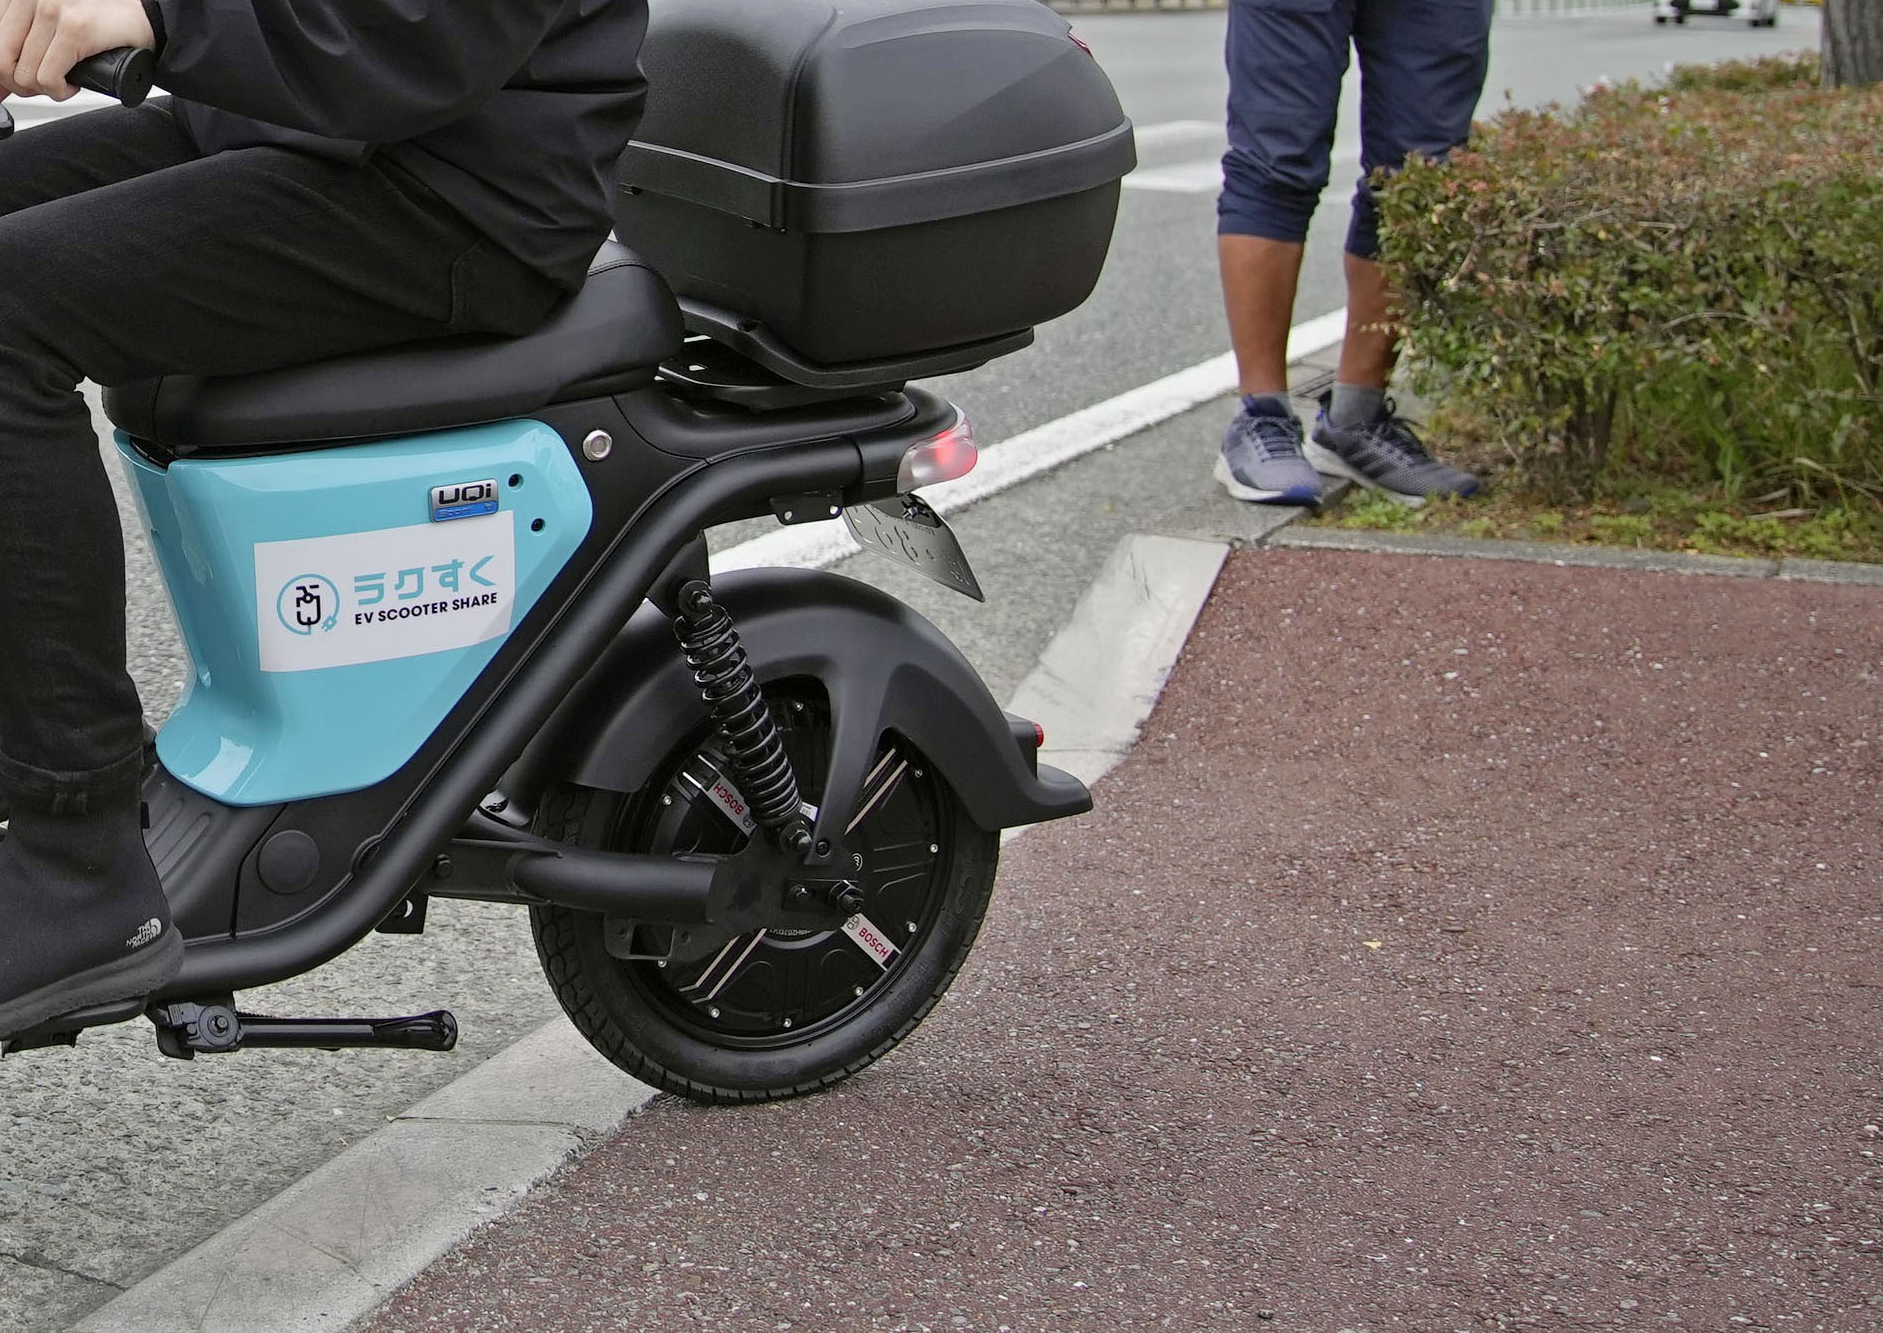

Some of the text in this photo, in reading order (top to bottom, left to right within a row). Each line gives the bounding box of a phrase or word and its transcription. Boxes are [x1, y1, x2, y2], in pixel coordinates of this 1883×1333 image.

[353, 555, 496, 606] ラクすく
[354, 592, 498, 626] EV SCOOTER SHARE
[713, 783, 745, 815] BOSCH
[858, 927, 889, 958] BOSCH
